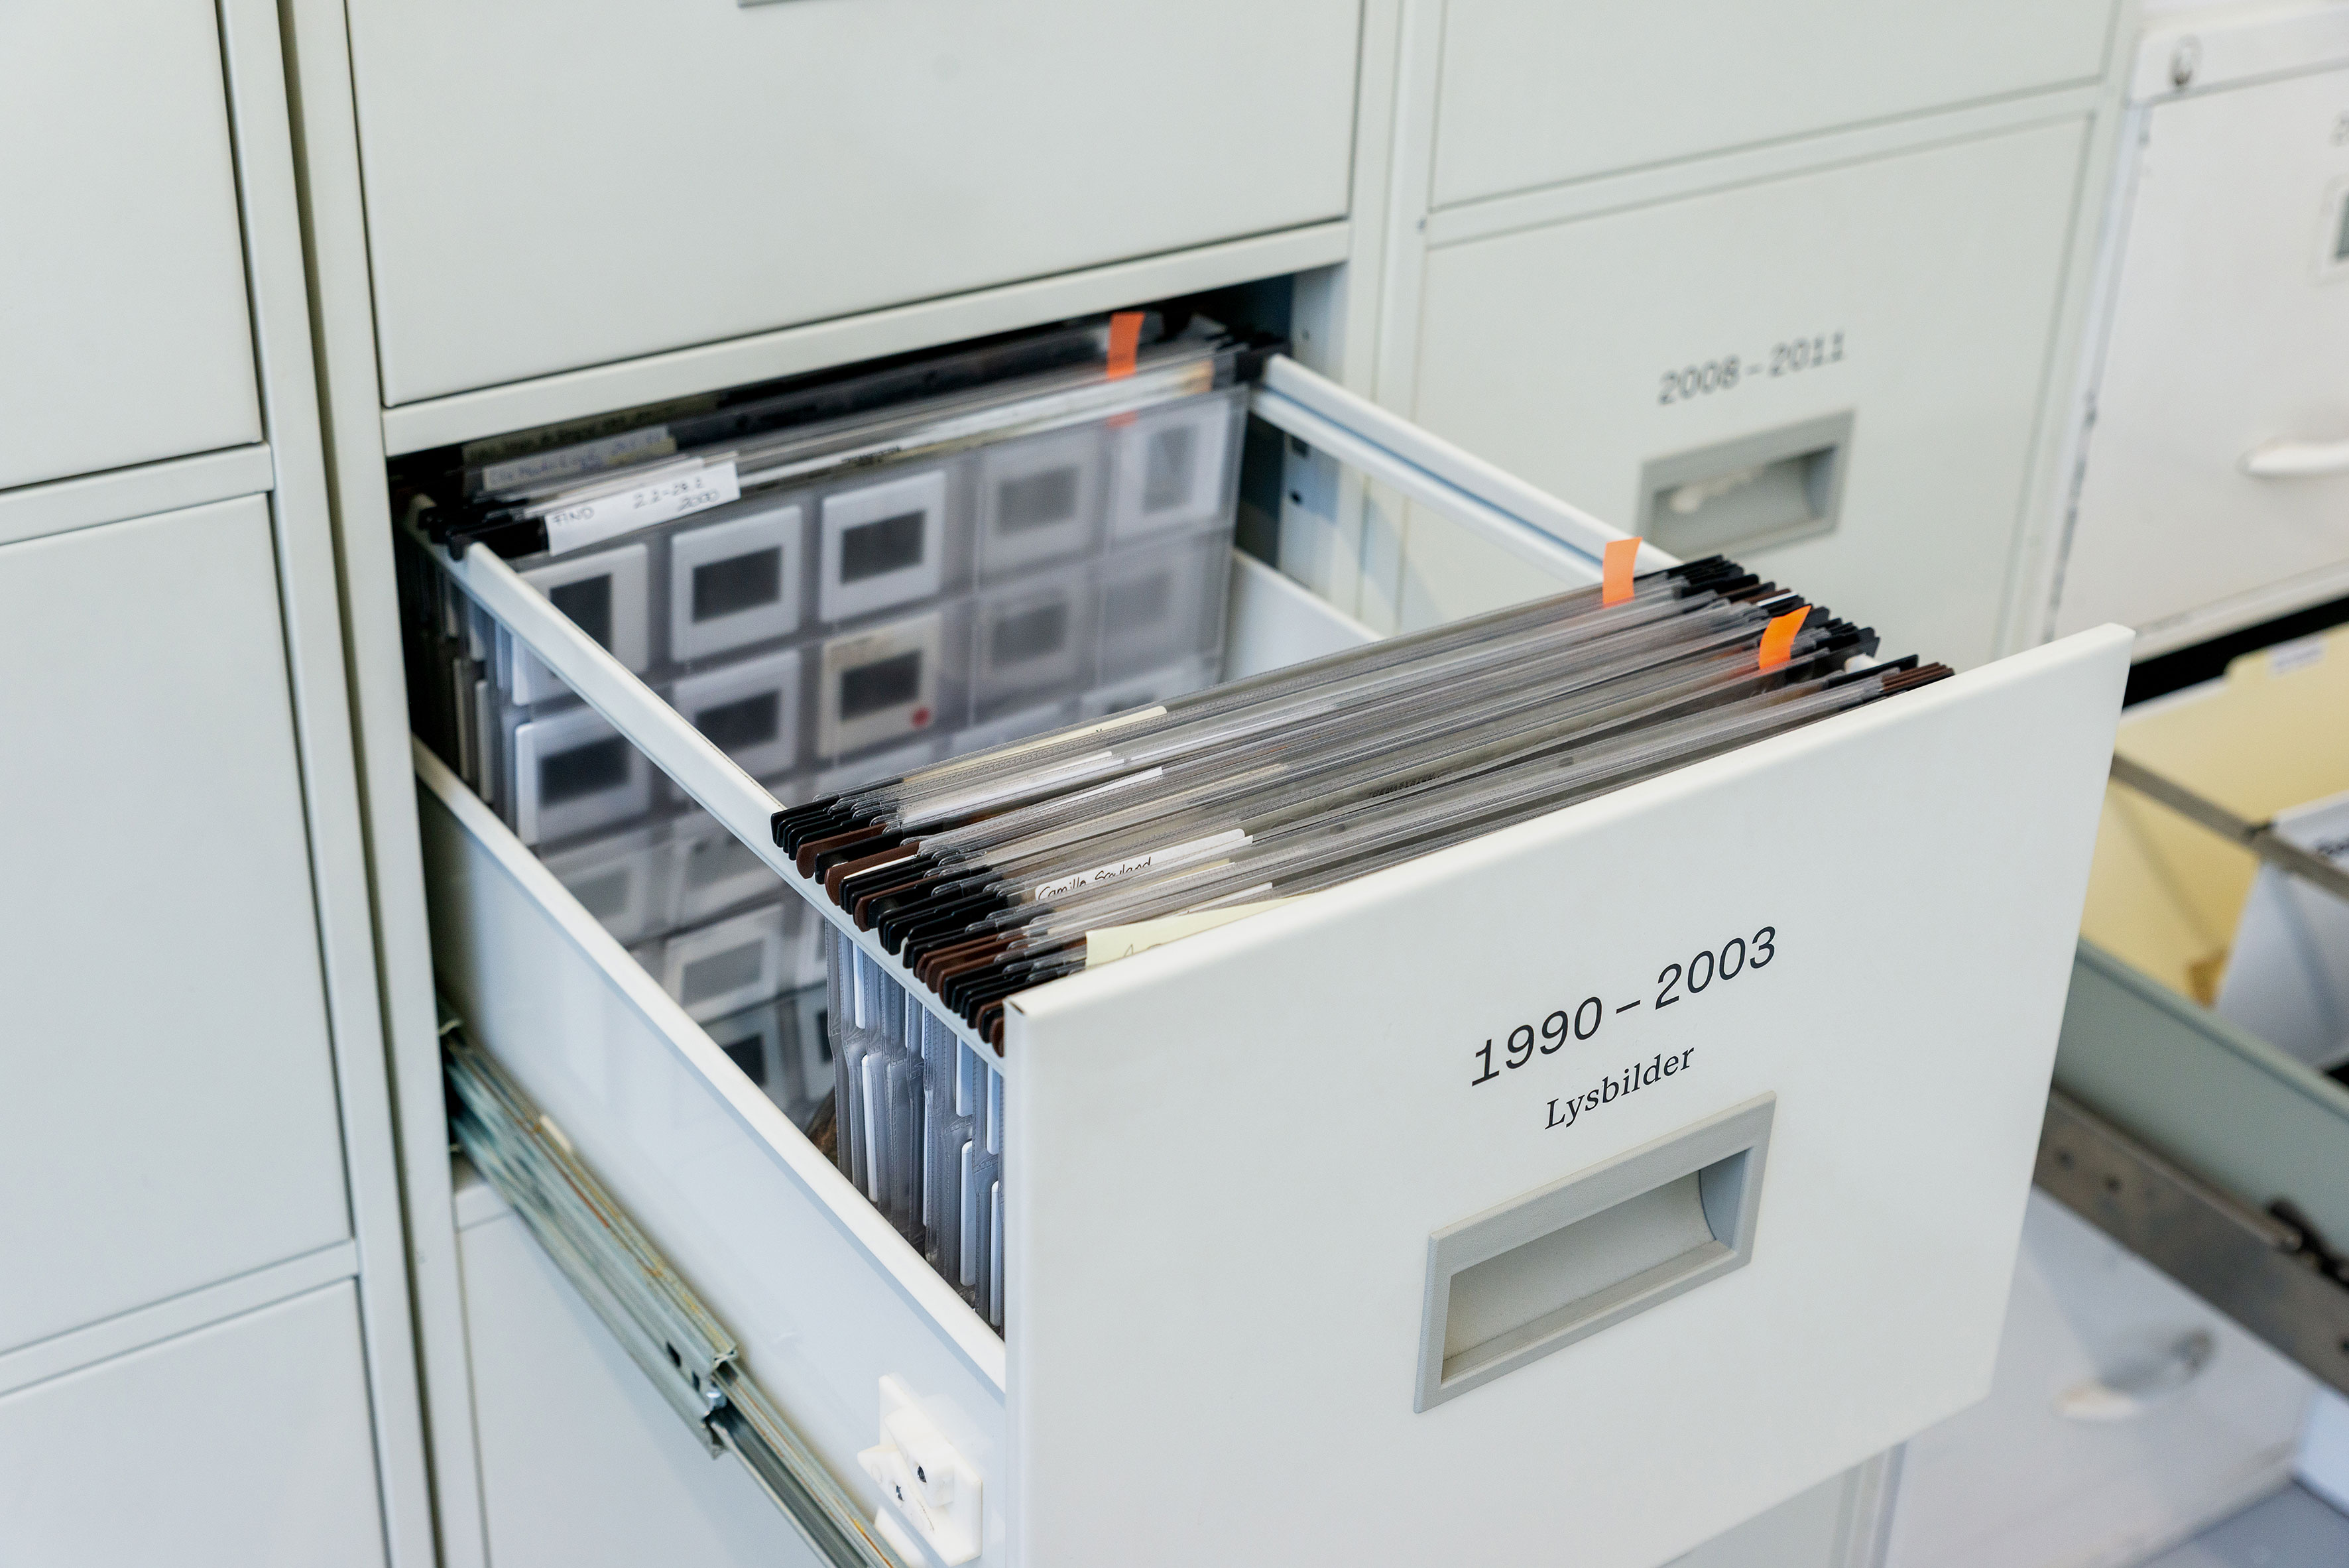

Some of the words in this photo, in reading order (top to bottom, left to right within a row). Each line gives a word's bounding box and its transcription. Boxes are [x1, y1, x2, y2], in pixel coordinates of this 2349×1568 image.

[1659, 353, 1740, 406] 2008
[1768, 329, 1844, 377] 2011
[1471, 996, 1602, 1087] 1990
[1654, 926, 1776, 1010] 2003
[1544, 1047, 1695, 1130] Lysbilder
